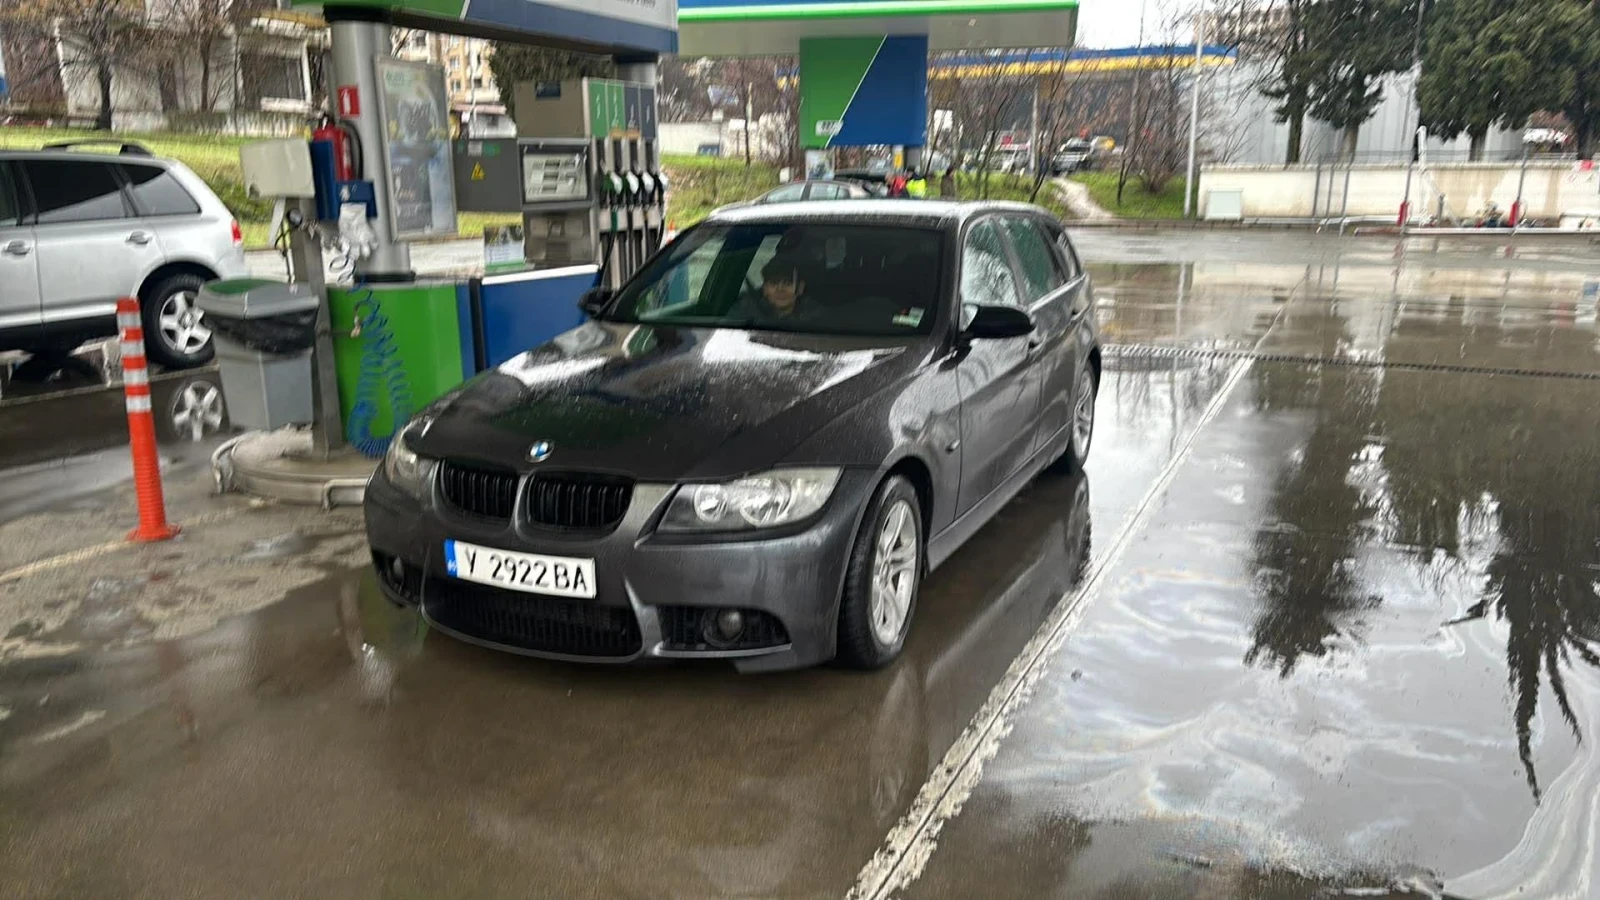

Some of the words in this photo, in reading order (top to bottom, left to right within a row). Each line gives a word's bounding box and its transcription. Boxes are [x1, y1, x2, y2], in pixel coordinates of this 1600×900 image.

[465, 547, 476, 577] Y
[489, 554, 549, 588] 2922
[554, 562, 588, 592] BA
